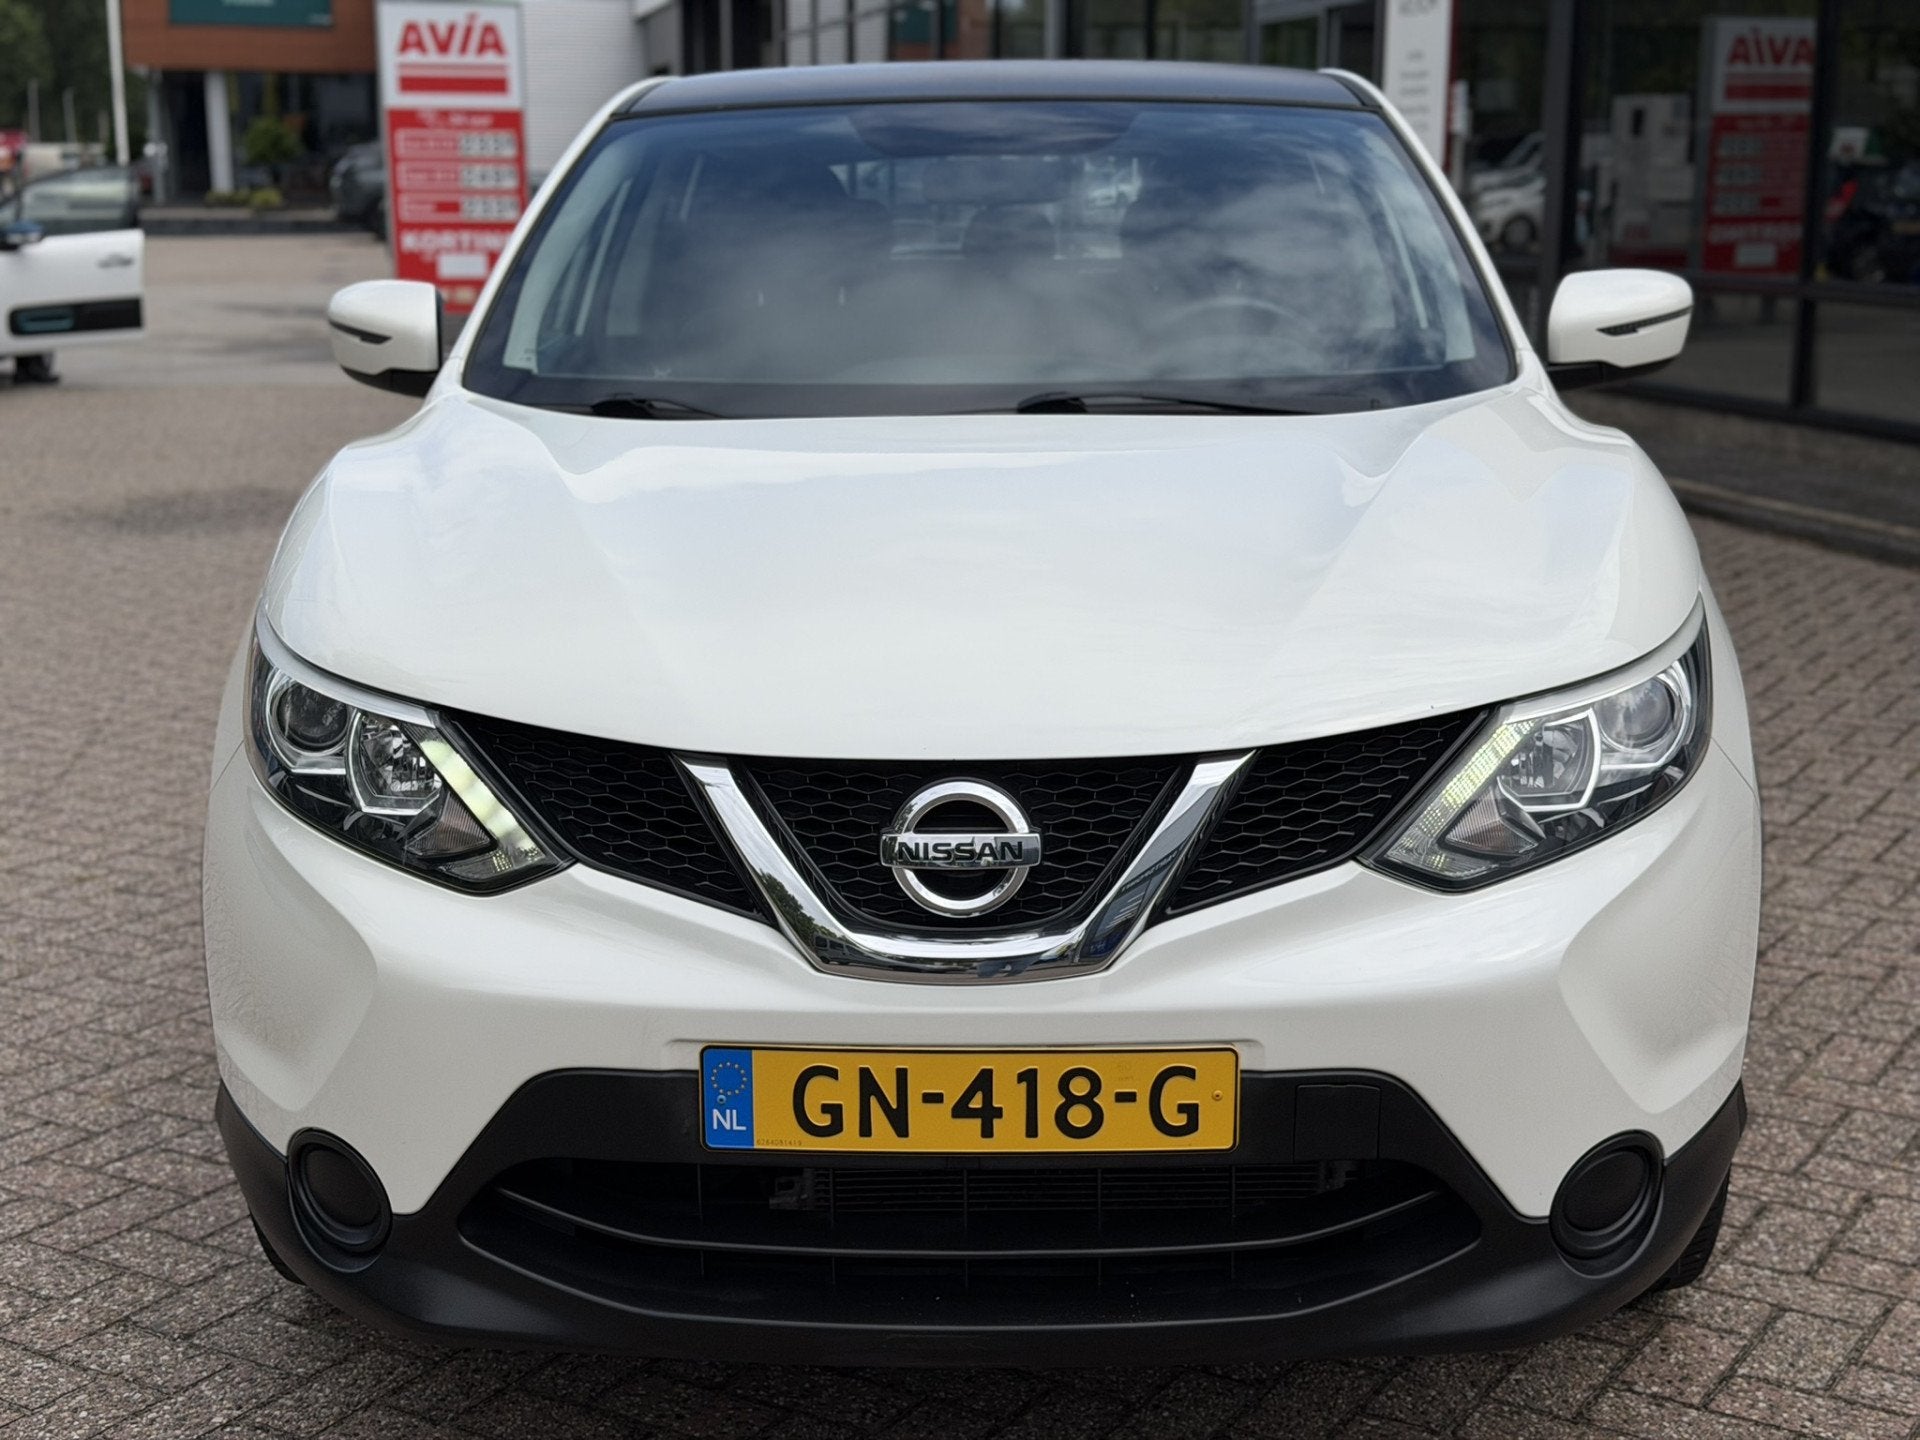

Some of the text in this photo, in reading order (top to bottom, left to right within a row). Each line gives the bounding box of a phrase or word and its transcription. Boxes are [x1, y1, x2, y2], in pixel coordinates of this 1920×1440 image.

[897, 841, 1023, 861] NISSAN
[791, 1064, 1201, 1139] GN-418-G
[712, 1108, 748, 1131] NL
